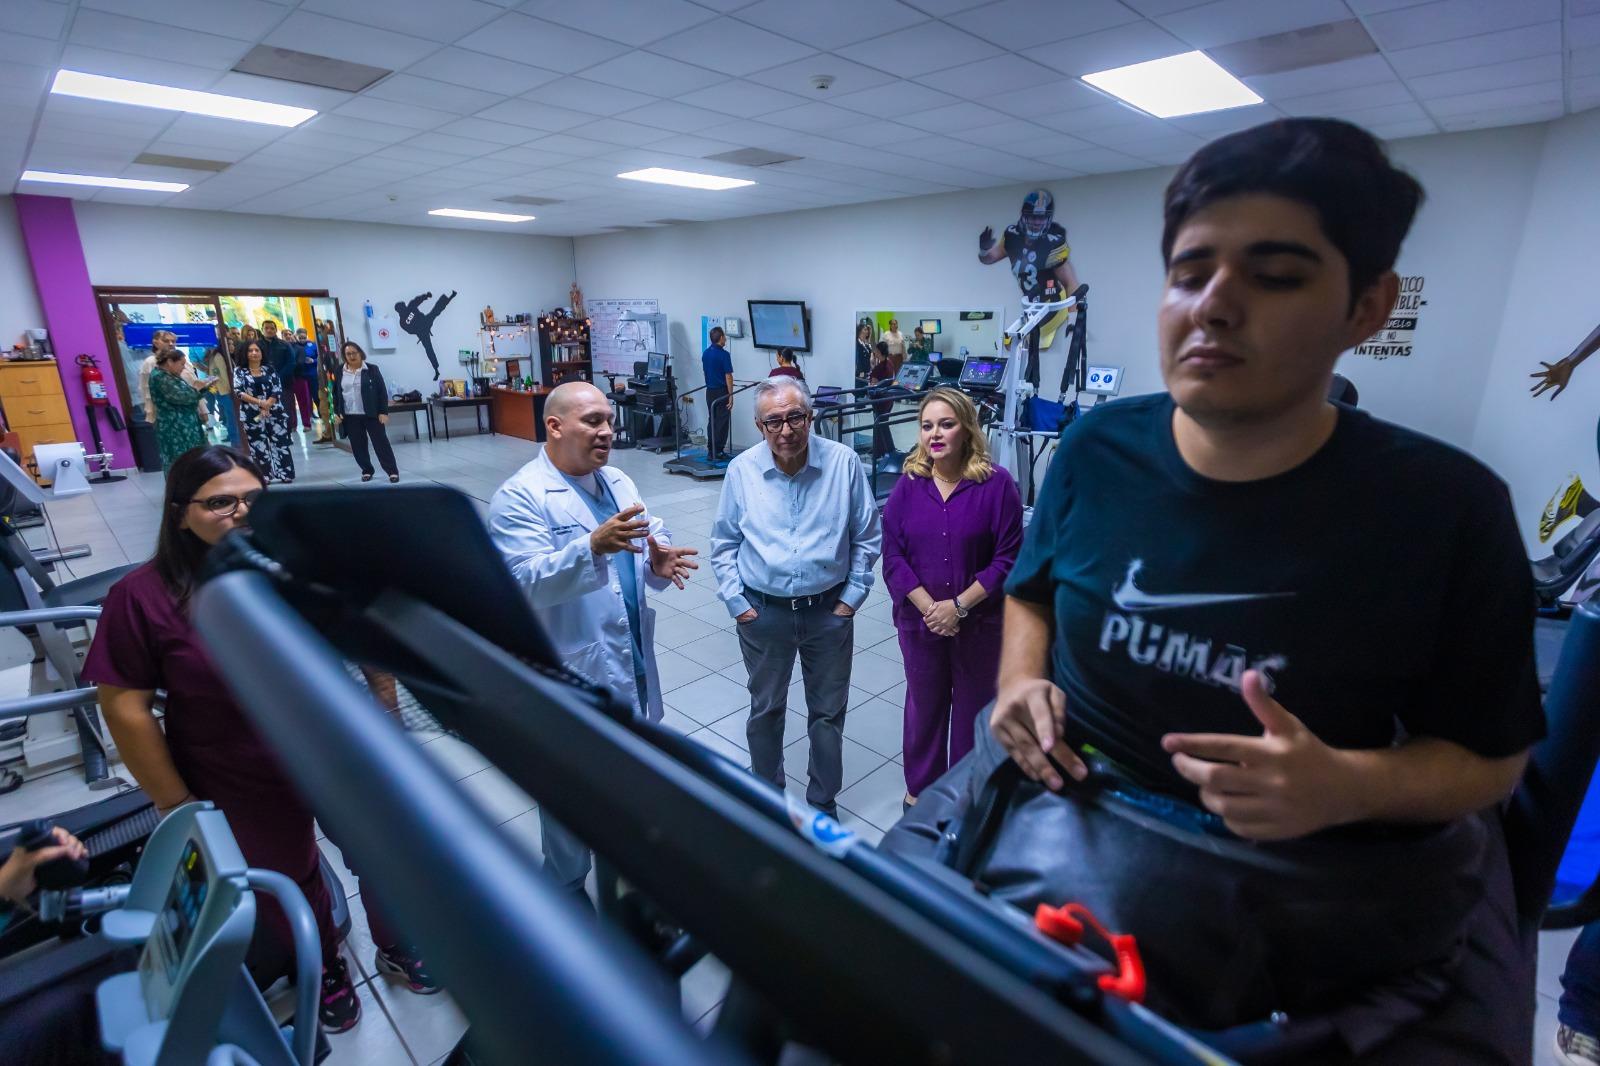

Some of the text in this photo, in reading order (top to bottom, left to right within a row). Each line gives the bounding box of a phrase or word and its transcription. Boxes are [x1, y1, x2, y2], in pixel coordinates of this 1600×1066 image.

[1400, 277, 1424, 292] ICO
[1394, 295, 1420, 310] IBLE
[1354, 345, 1413, 357] INTENTAS
